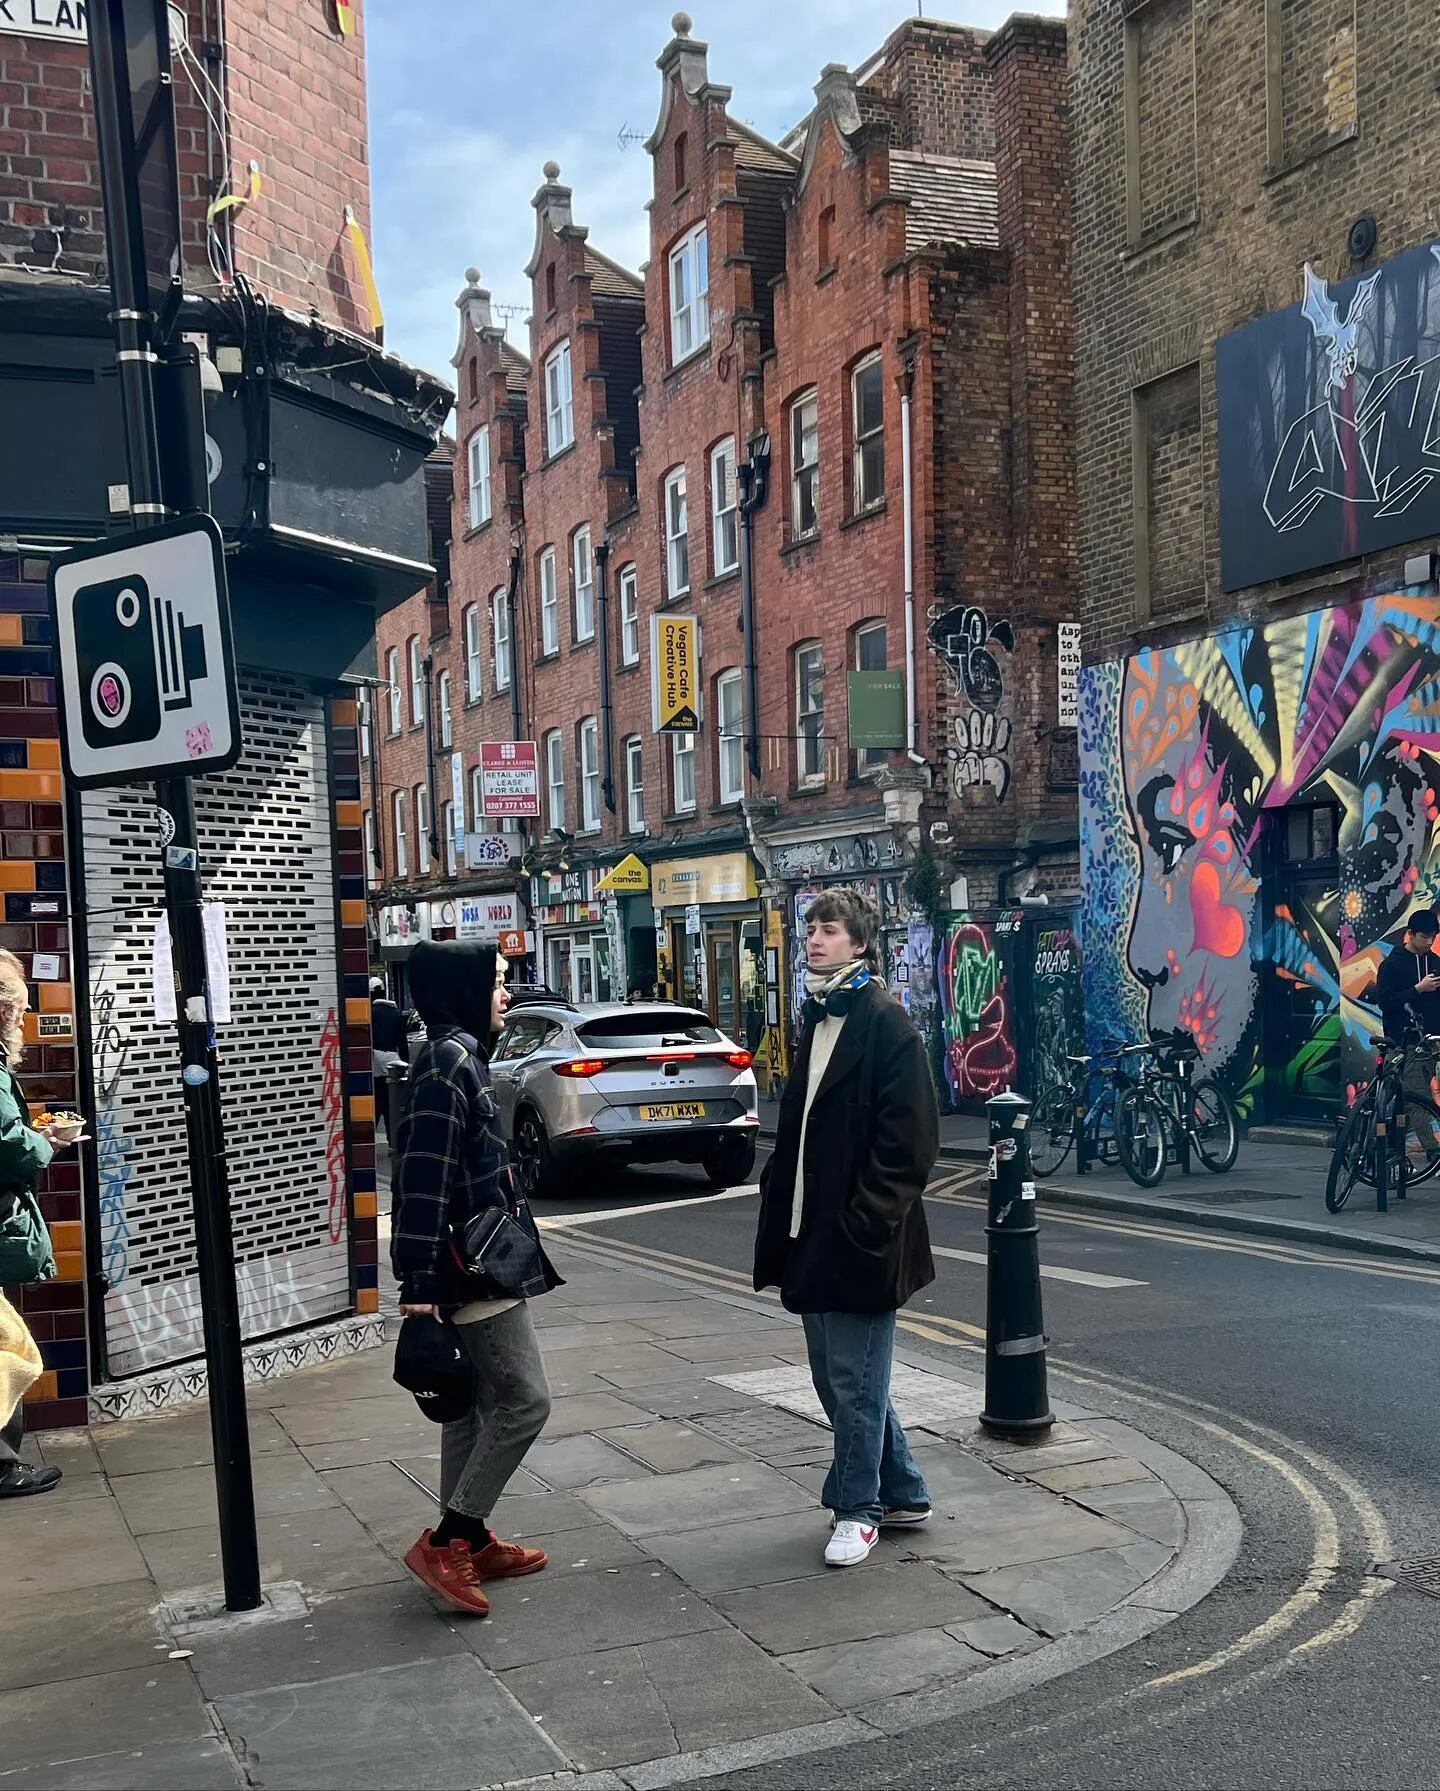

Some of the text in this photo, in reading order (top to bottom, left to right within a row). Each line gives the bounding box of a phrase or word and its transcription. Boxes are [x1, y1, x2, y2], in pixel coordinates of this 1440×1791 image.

[1061, 641, 1073, 649] to
[666, 625, 676, 708] Creative Hub
[676, 625, 689, 699] Vegan Cafe
[486, 771, 513, 779] RETAIL
[496, 779, 523, 787] LEASE
[509, 786, 530, 794] SALE
[505, 802, 517, 810] 377
[628, 869, 641, 877] the
[565, 871, 580, 887] ONE
[487, 904, 512, 921] WORLD
[1035, 949, 1070, 975] SPRAYS
[648, 1105, 675, 1118] DK71
